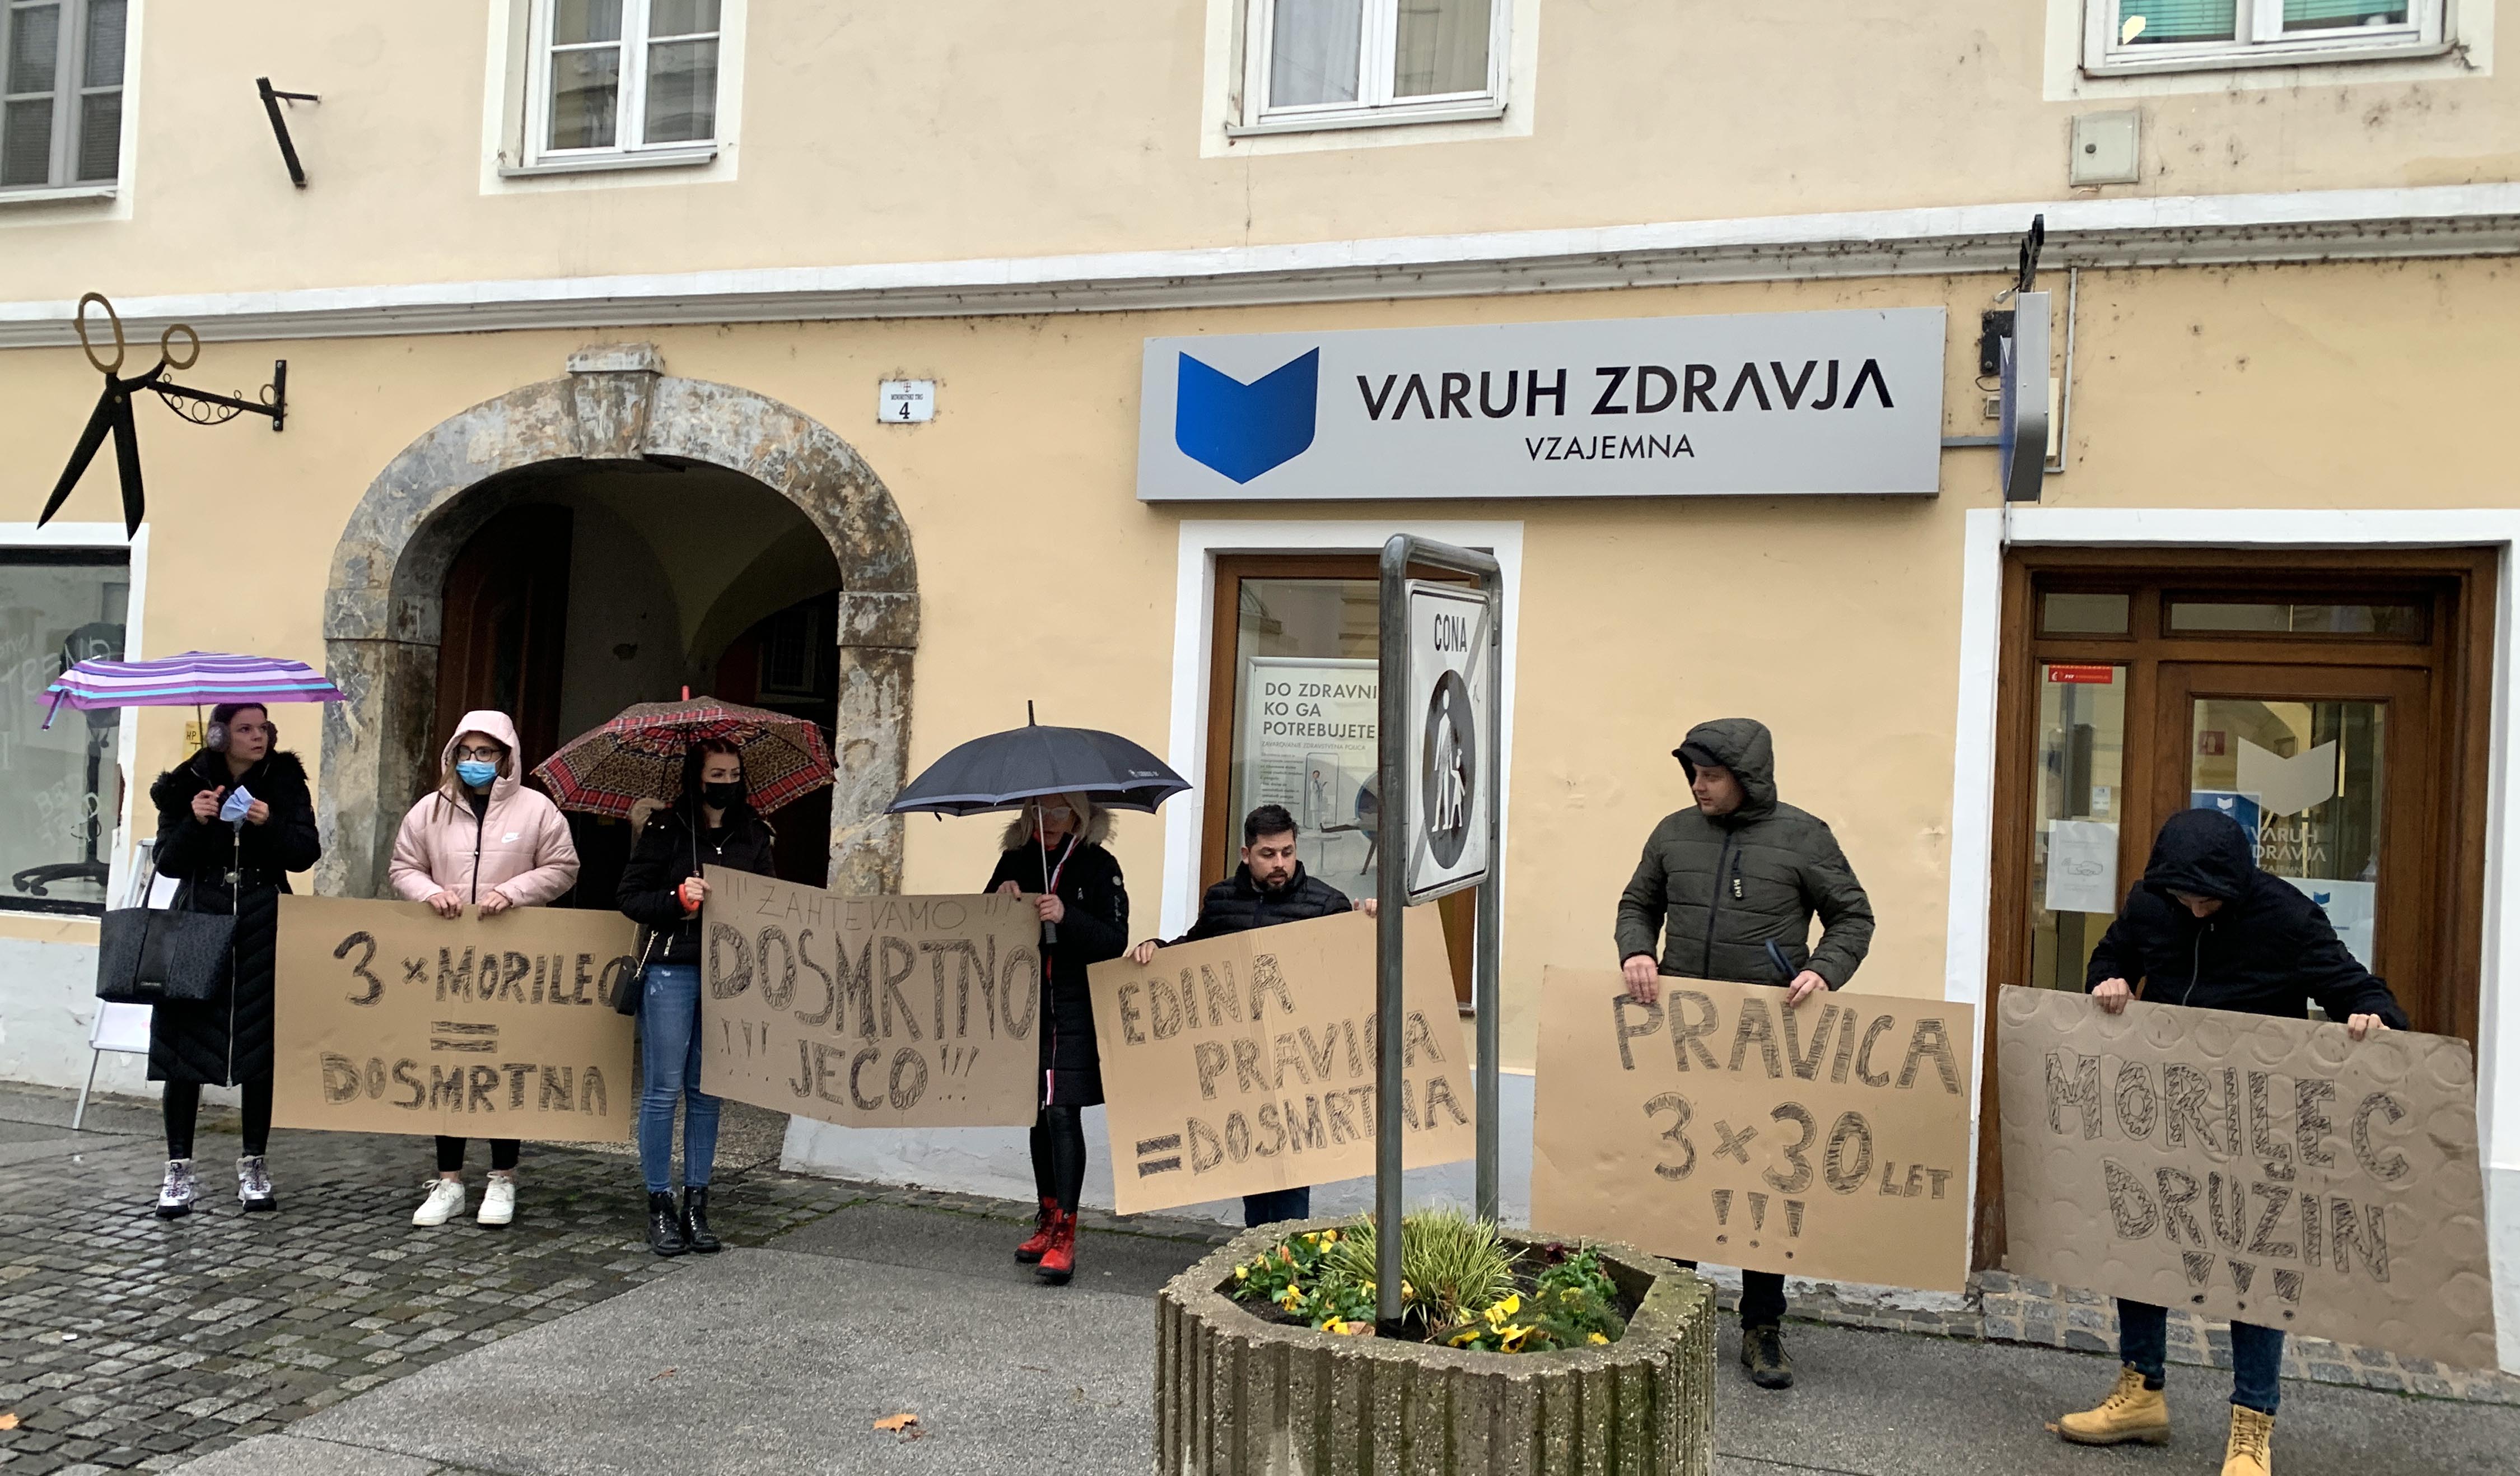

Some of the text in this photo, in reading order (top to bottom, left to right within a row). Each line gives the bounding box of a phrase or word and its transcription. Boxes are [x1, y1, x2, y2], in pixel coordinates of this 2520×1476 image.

[1356, 358, 1894, 420] VARUH ZDRAVJA
[899, 402, 910, 419] 4
[1525, 434, 1695, 461] VZAJEMNA
[1435, 613, 1467, 652] CONA
[1265, 682, 1291, 696] DO
[1264, 702, 1322, 717] KO GA
[1263, 721, 1375, 738] POTREBUJETE
[2250, 826, 2318, 844] VARUH
[2250, 844, 2326, 862] DRAVJA
[756, 885, 967, 931] ZAHTEVAMO
[708, 921, 1042, 1041] DOSMRTNO
[1117, 953, 1296, 1046] EDINA
[1613, 990, 1963, 1096] PRAVICA
[320, 1051, 607, 1116] DOSMRTNA
[2045, 1052, 2410, 1182] MORILEC
[1879, 1160, 1953, 1199] LET
